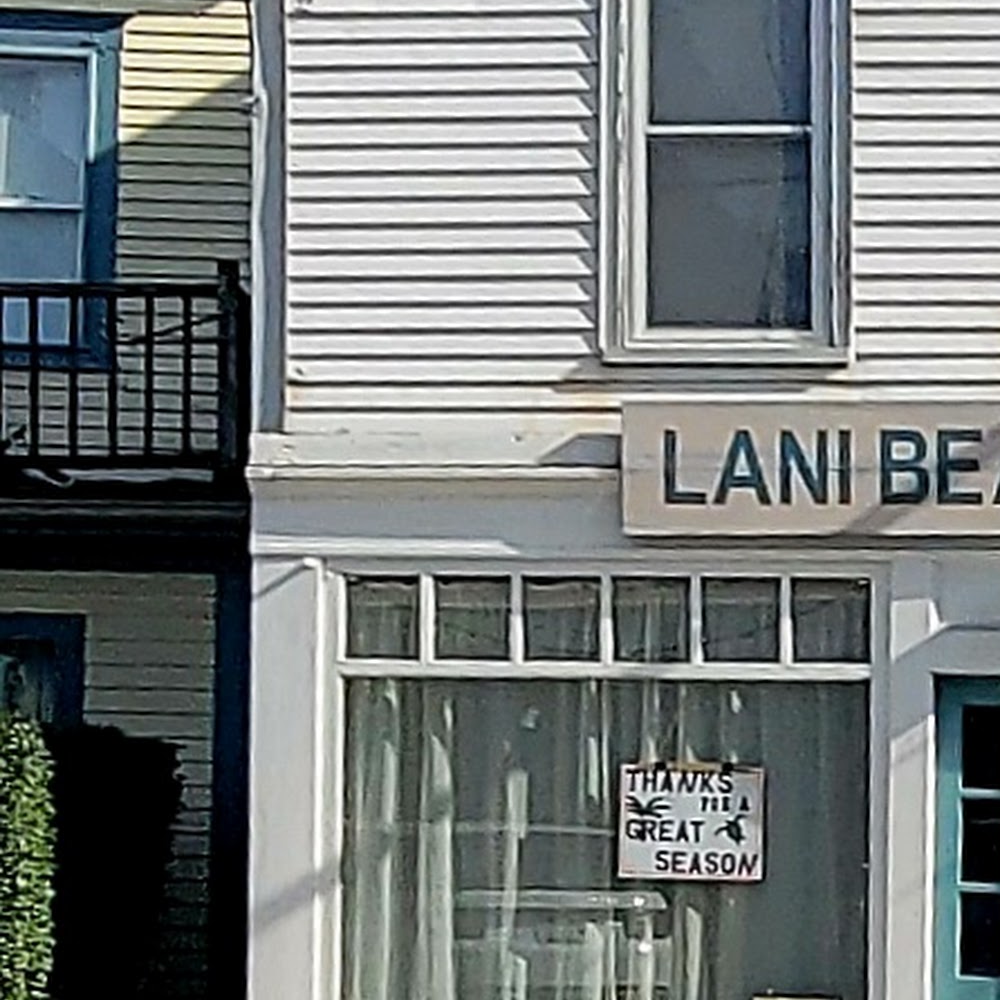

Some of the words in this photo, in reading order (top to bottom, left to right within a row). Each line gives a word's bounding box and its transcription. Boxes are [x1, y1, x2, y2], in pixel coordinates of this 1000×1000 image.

[662, 427, 851, 507] LANI
[625, 768, 733, 794] THANKS
[740, 796, 750, 812] A
[625, 819, 705, 843] GREAT
[654, 850, 759, 876] SEASON
